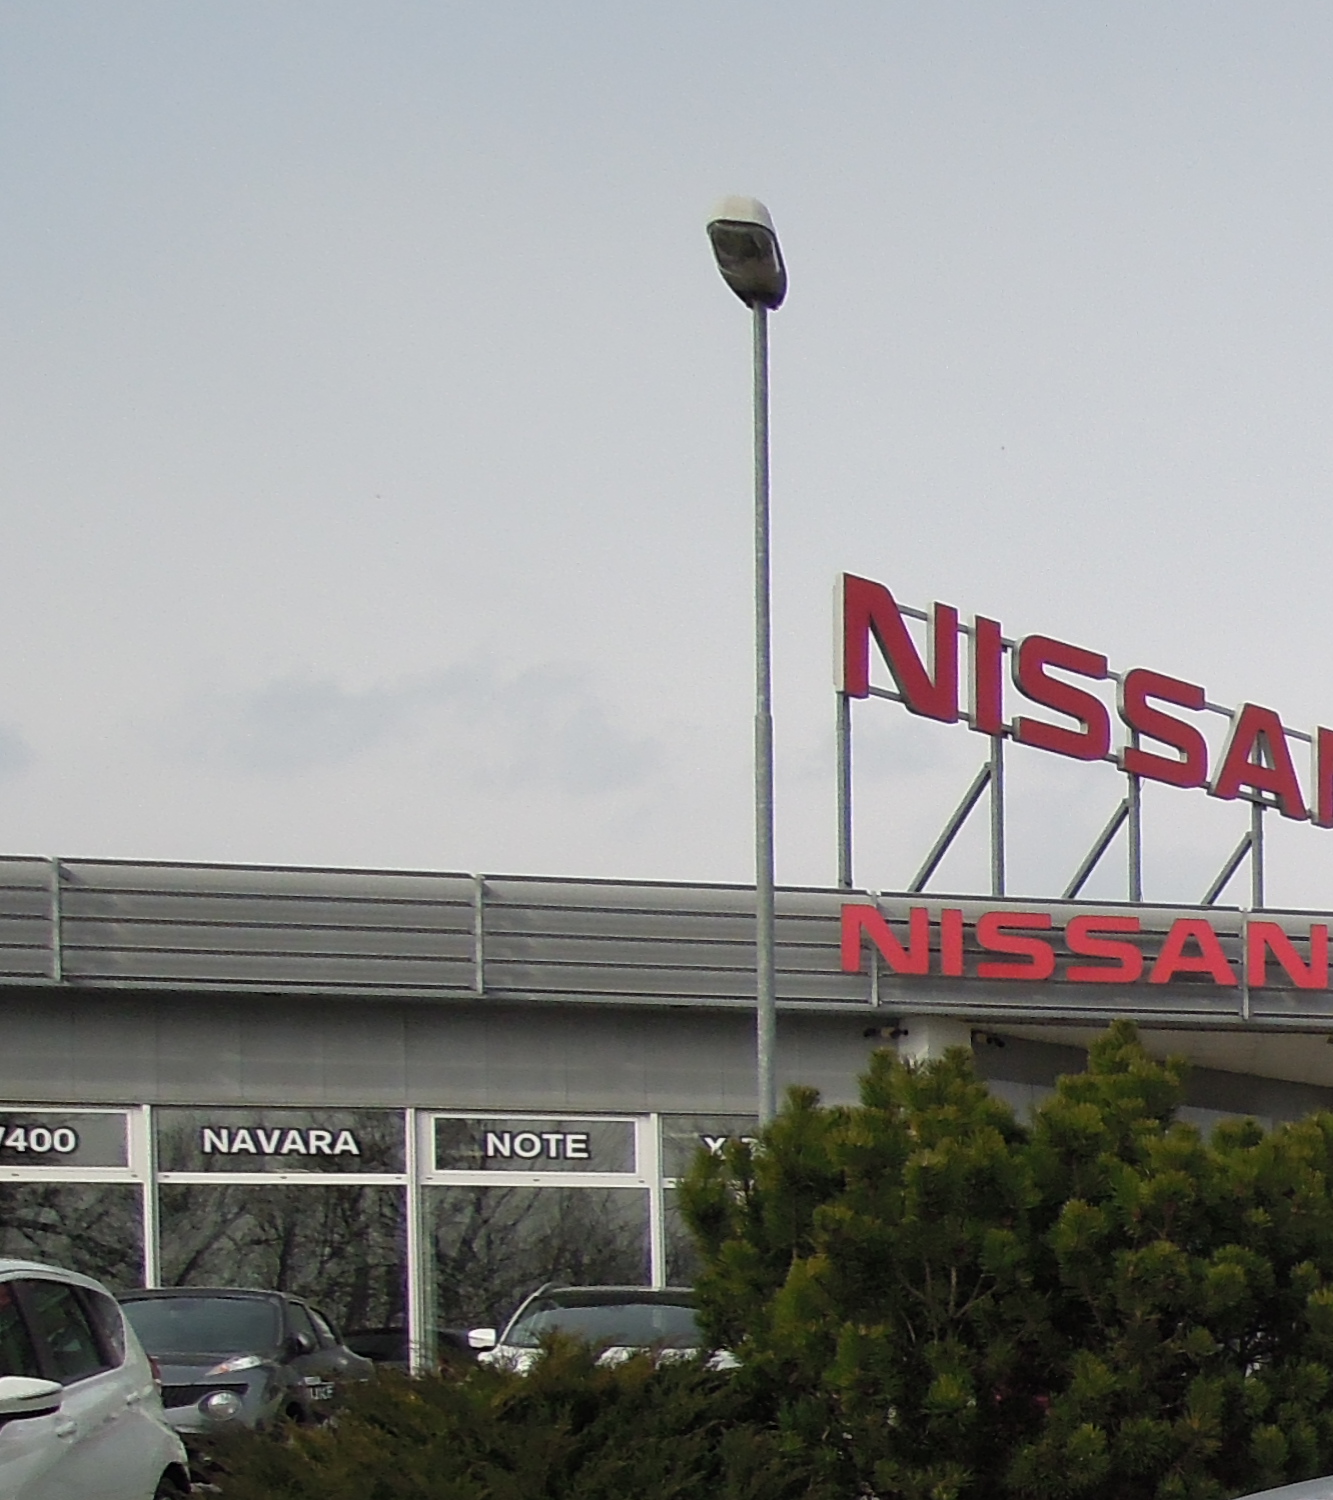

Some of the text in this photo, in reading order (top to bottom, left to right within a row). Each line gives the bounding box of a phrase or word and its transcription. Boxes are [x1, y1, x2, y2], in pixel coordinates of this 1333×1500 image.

[840, 903, 1329, 989] NISSAN
[0, 1126, 76, 1153] 400
[203, 1128, 360, 1155] NAVARA
[486, 1132, 589, 1158] NOTE
